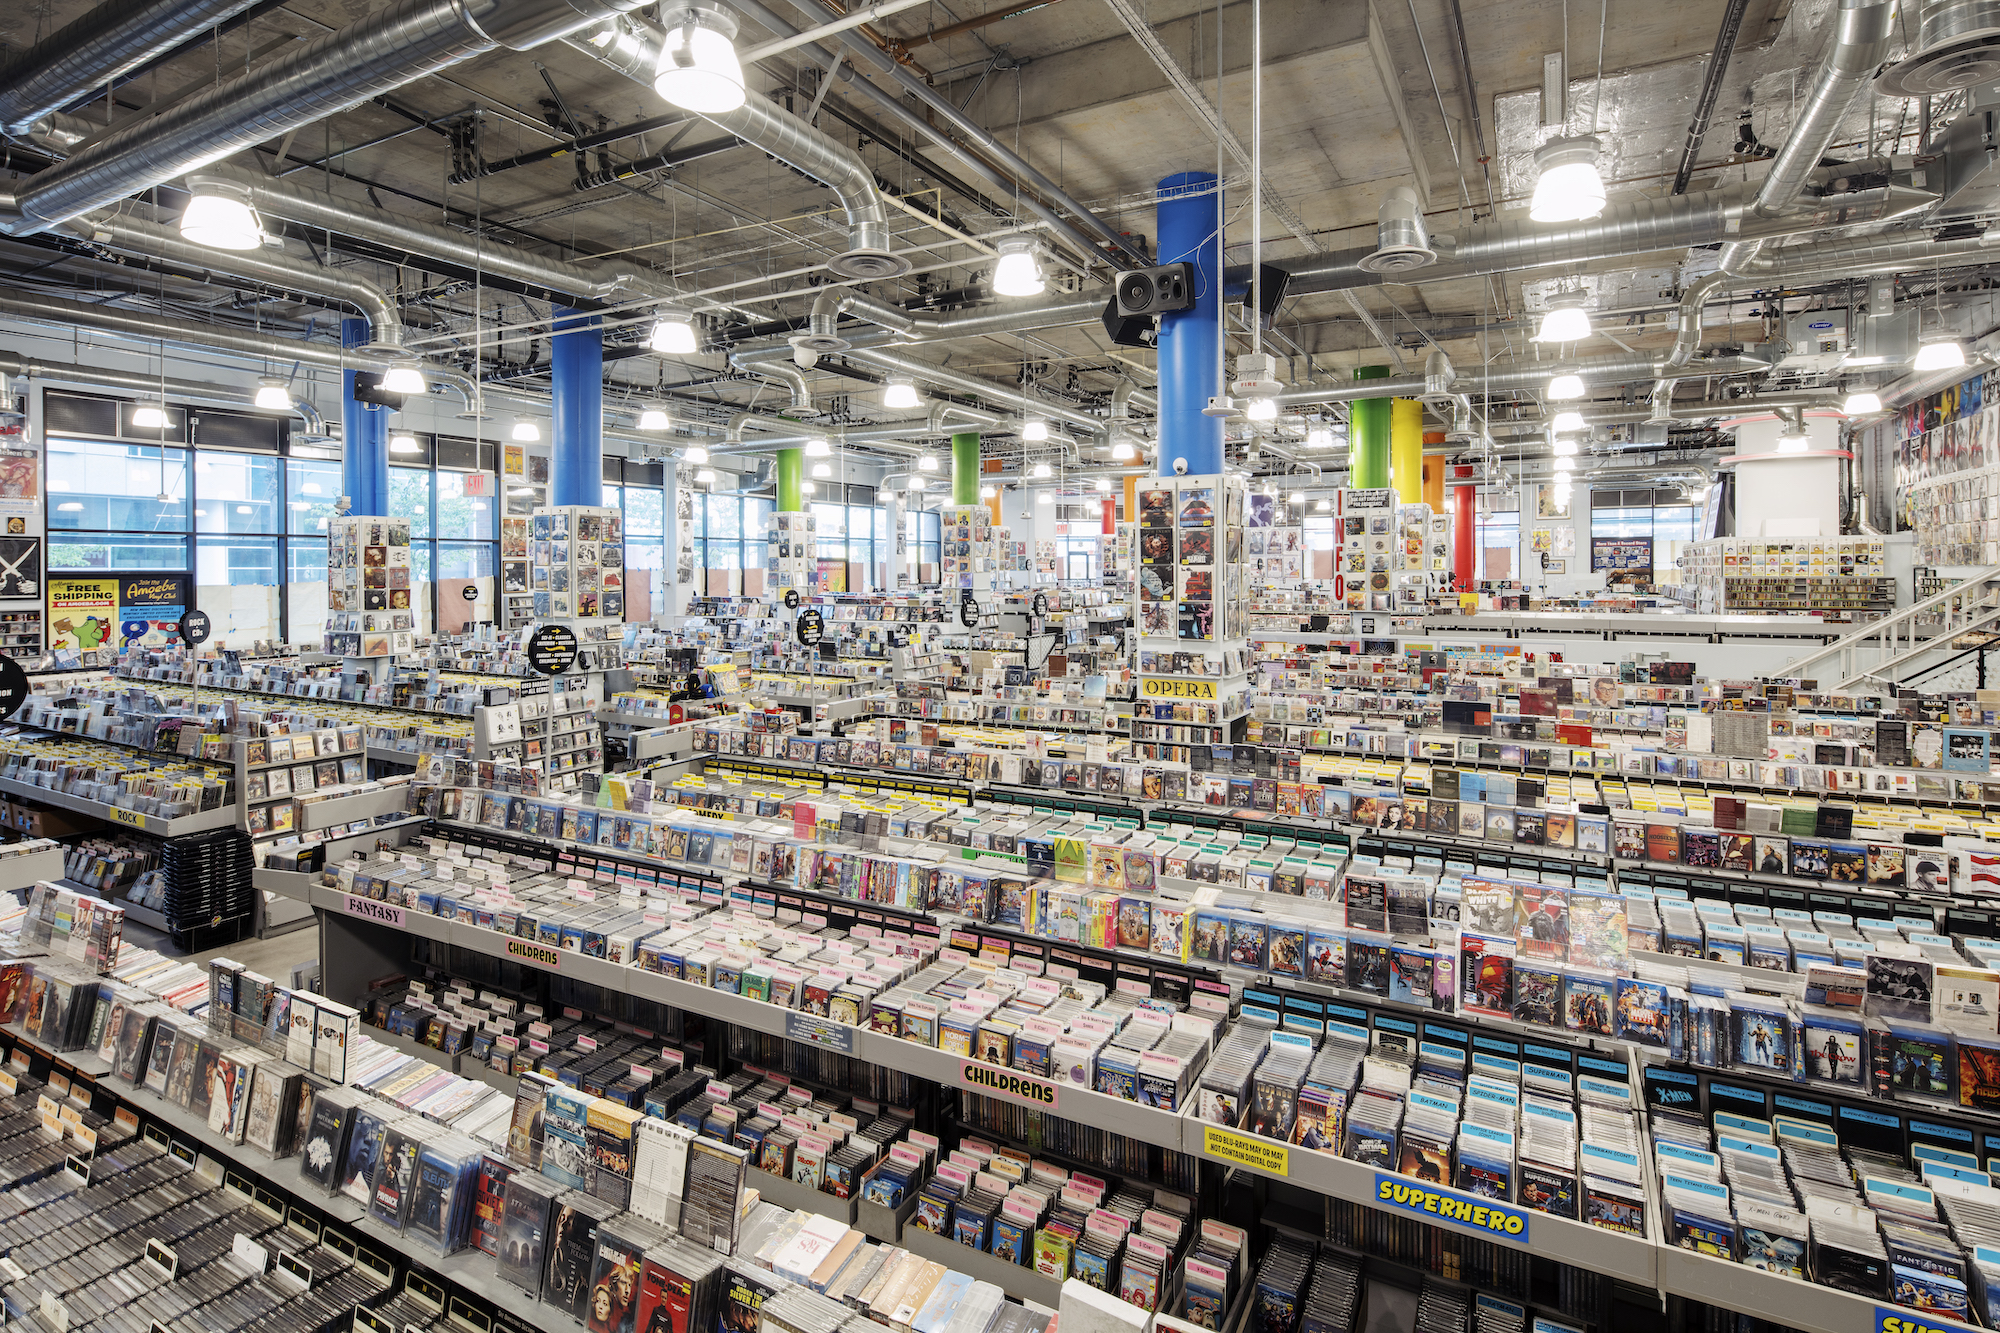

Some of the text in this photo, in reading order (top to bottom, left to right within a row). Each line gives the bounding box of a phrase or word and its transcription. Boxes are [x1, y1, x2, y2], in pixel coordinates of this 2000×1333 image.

[467, 475, 484, 496] EXIT
[1335, 490, 1344, 600] INFO
[126, 579, 177, 599] Amoeba
[53, 592, 113, 600] SHIPPING
[148, 593, 162, 602] Vinyl
[188, 618, 205, 627] ROCK
[192, 628, 204, 638] CDs
[1010, 674, 1020, 682] 50
[1145, 680, 1213, 698] OPERA
[117, 810, 137, 824] ROCK
[1649, 834, 1678, 842] HOOSIERS
[1468, 896, 1498, 905] WHITE
[1601, 900, 1620, 908] WAR
[350, 898, 400, 924] FANTASY
[1202, 982, 1221, 990] CHILDRENS
[1572, 982, 1606, 994] JUSTICE LEAGUE
[1630, 1007, 1654, 1020] MARVEL
[944, 1030, 964, 1042] NORM
[984, 1032, 1002, 1042] Paddington
[944, 1040, 964, 1050] NORTH
[1424, 1046, 1462, 1058] JUSTICE LEAGUE
[181, 1060, 195, 1074] GIFT
[1528, 1066, 1566, 1080] SUPERMAN
[1106, 1072, 1128, 1086] SING
[1472, 1089, 1515, 1104] SPIDER-MAN
[1656, 1087, 1693, 1103] X-MEN
[1420, 1098, 1448, 1110] BATMAN
[1842, 1110, 1872, 1120] SUPERHEROES
[1470, 1125, 1504, 1137] JUSTICE LEAGUE
[1913, 1124, 1946, 1134] SUPERHEROES
[1208, 1132, 1284, 1161] USED BLU-RAYS MAY OR MAY
[1210, 1143, 1281, 1171] NOT CONTAIN DIGITAL COPY
[1684, 1151, 1713, 1160] ANIMATED
[798, 1156, 817, 1168] DROOPY
[422, 1170, 450, 1189] SLEUTH
[1524, 1172, 1562, 1187] SUPERMAN
[1684, 1180, 1702, 1188] TITANS
[1704, 1184, 1724, 1193] (CONT.)
[376, 1190, 398, 1209] PAYBACK
[1379, 1181, 1524, 1236] SUPERHERO
[1748, 1206, 1770, 1216] X-MEN
[1834, 1207, 1842, 1216] C
[567, 1240, 581, 1251] THEM
[158, 1252, 162, 1261] E
[570, 1249, 591, 1262] FOLLOW
[598, 1250, 626, 1267] CONDOR
[646, 1272, 687, 1298] TONE-DEAF
[729, 1290, 750, 1306] SILVER
[736, 1286, 763, 1302] UNDER THE
[370, 1318, 376, 1328] M
